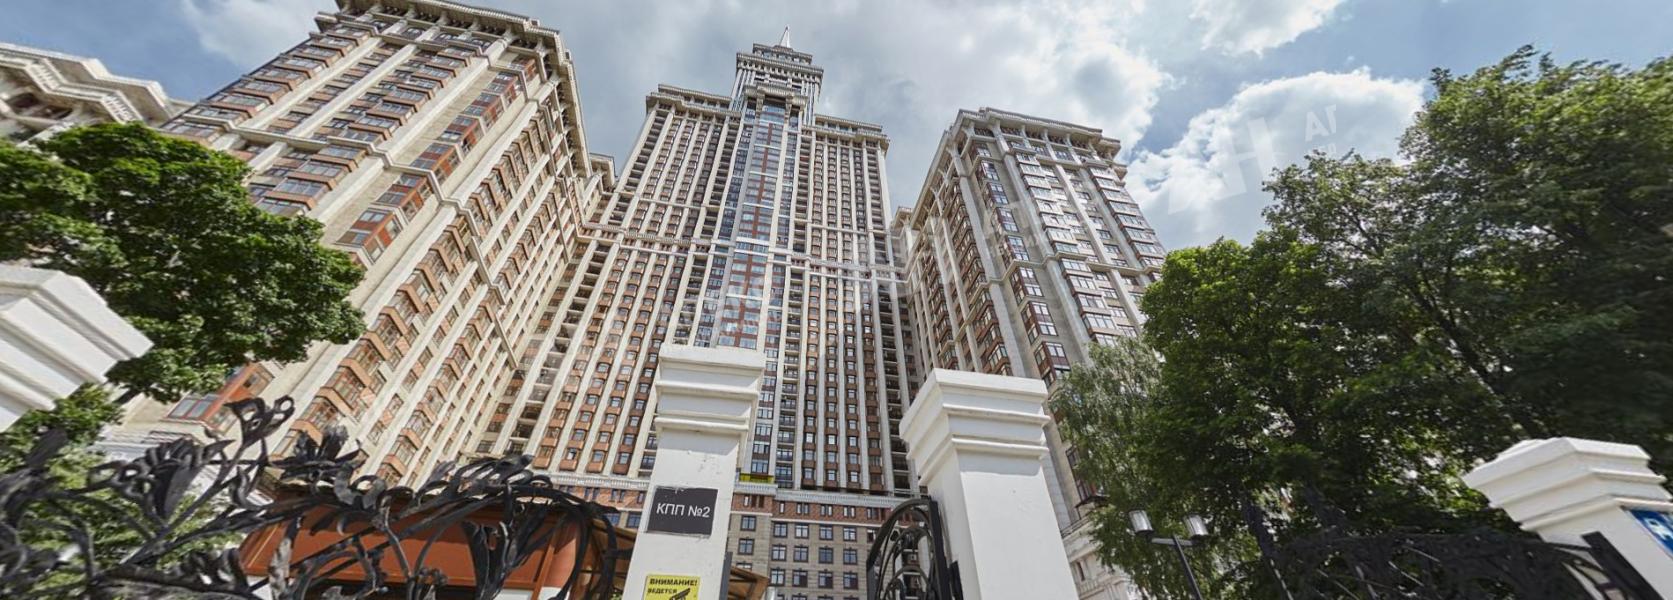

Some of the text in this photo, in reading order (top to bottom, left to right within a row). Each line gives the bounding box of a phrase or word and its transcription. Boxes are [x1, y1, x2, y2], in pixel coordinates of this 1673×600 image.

[656, 503, 711, 518] КПП №2
[649, 578, 698, 587] ВНИМАНИЕ!
